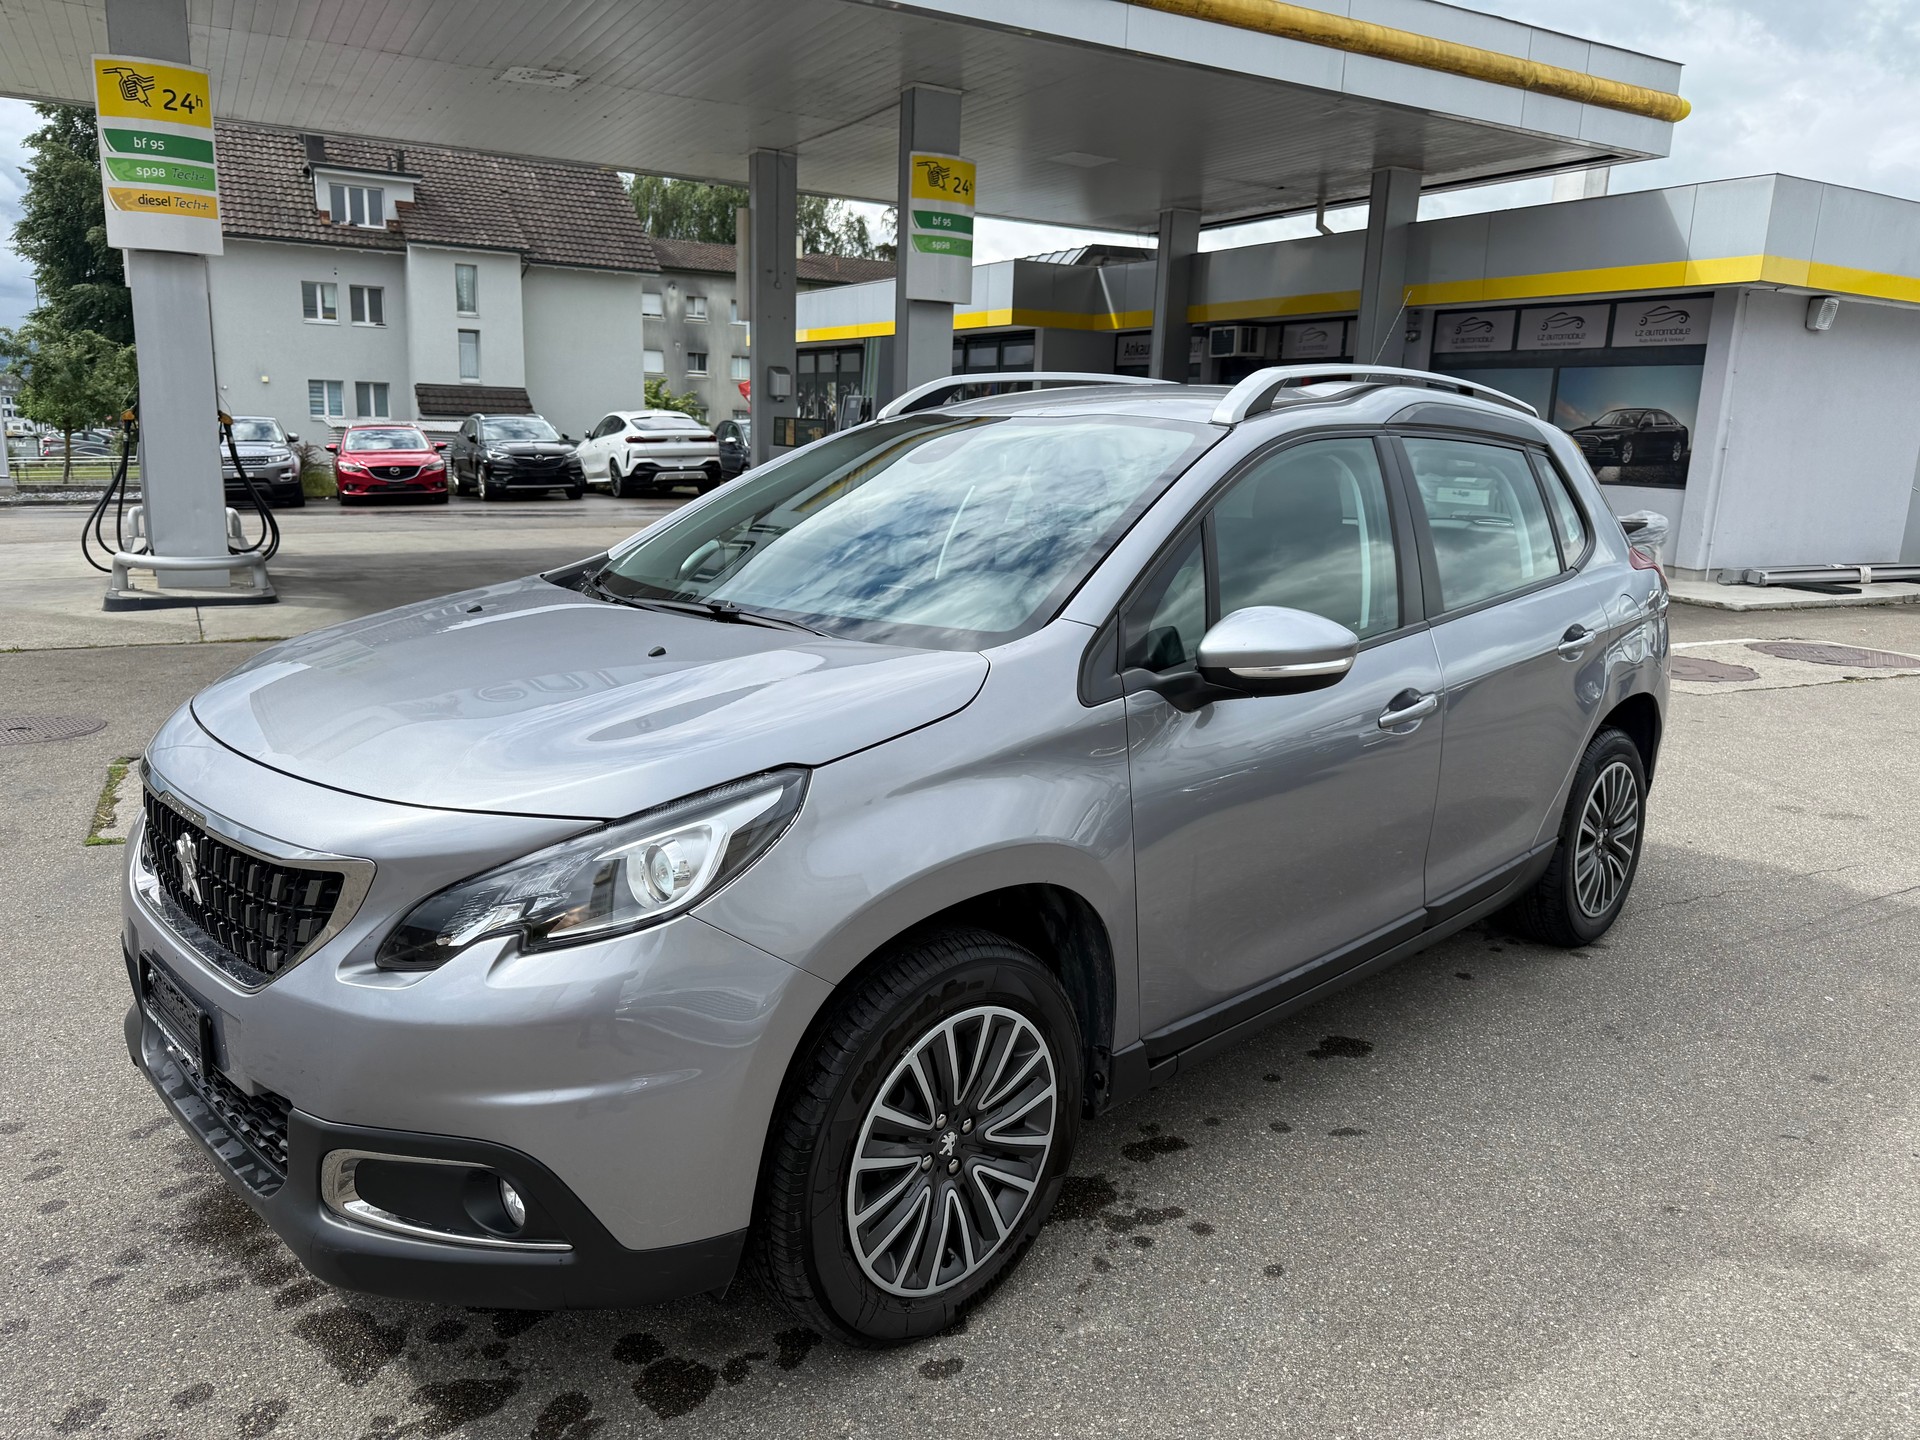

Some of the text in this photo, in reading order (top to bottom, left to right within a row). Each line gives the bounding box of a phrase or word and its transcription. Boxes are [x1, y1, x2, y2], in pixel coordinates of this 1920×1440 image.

[133, 136, 165, 151] bf 95
[136, 166, 208, 182] sp98 Tech+
[137, 193, 209, 211] diesel Tech+
[932, 215, 952, 227] bf 95
[1124, 341, 1150, 356] Ankau
